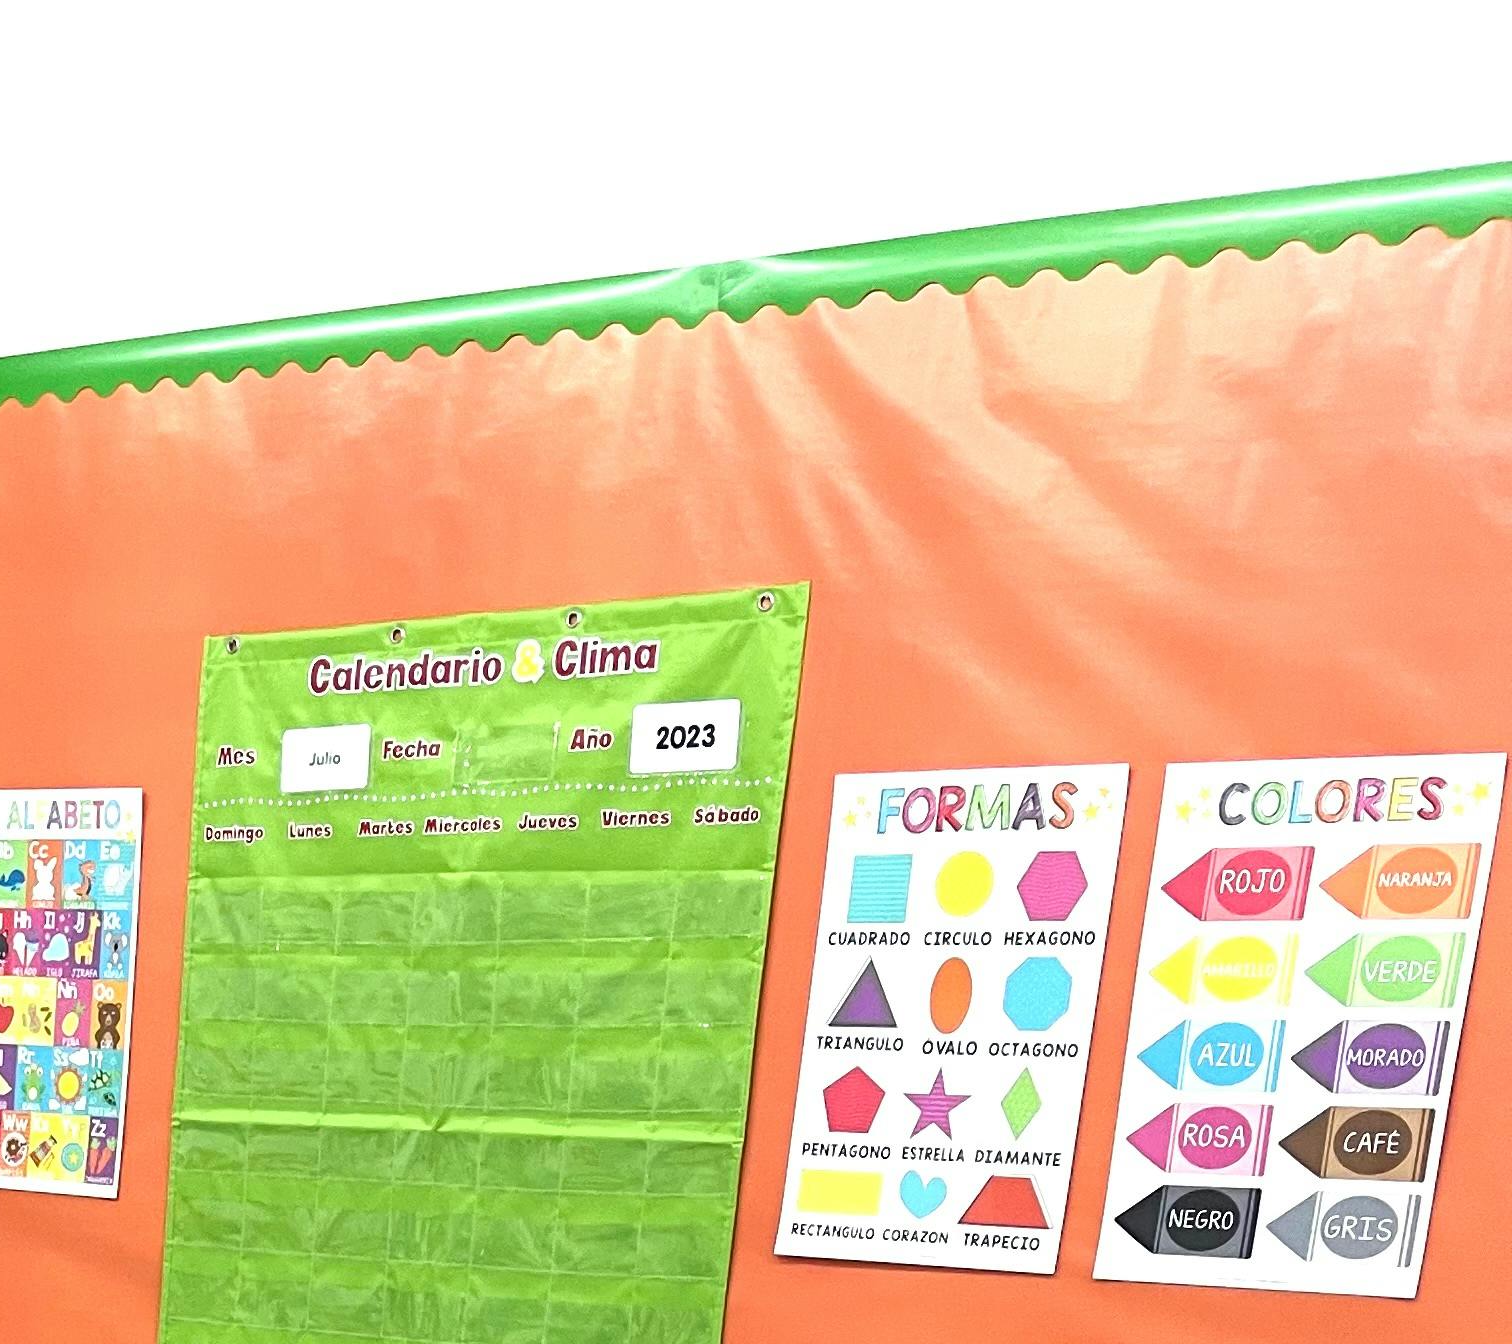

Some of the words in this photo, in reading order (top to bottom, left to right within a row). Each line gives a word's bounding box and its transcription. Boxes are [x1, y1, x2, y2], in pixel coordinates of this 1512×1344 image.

[309, 649, 502, 694] Calendario
[554, 640, 658, 677] Clima
[218, 746, 255, 766] Mes
[308, 752, 341, 766] Julio
[383, 740, 441, 761] Fecha
[570, 728, 612, 751] Año
[656, 723, 717, 750] 2023
[876, 781, 1079, 835] FORMAS
[1218, 776, 1448, 826] COLORES
[205, 826, 264, 843] Domingo
[289, 824, 332, 838] Lunes
[359, 820, 414, 836] Martes
[518, 814, 578, 830] Jueves
[601, 811, 670, 826] Viernes
[28, 841, 49, 859] Cc
[64, 841, 86, 860] Dd
[99, 841, 121, 860] Ee
[1219, 868, 1286, 894] ROJO
[1378, 872, 1453, 889] NARANJA
[13, 910, 32, 929] Hh
[103, 911, 122, 930] Kk
[828, 931, 911, 946] CUADRADO
[71, 967, 98, 977] JIRAFA
[1362, 959, 1437, 984] VERDE
[93, 983, 115, 1001] Oo
[17, 1046, 36, 1065] Rr
[53, 1049, 70, 1066] Ss
[90, 1050, 103, 1068] Tt
[1196, 1042, 1257, 1068] AZUL
[1346, 1047, 1425, 1069] MORADO
[2, 1112, 28, 1132] Ww
[90, 1118, 107, 1137] Zz
[1182, 1125, 1246, 1149] ROSA
[802, 1142, 891, 1160] PENTAGONO
[901, 1146, 965, 1162] ESTRELLA
[974, 1149, 1062, 1167] DIAMANTE
[1343, 1129, 1400, 1156] CAFÉ
[1168, 1208, 1234, 1231] NEGRO
[1323, 1213, 1393, 1243] GRIS
[791, 1222, 875, 1240] RECTANGULO
[882, 1228, 949, 1245] CORAZON
[963, 1232, 1041, 1251] TRAPECIO
